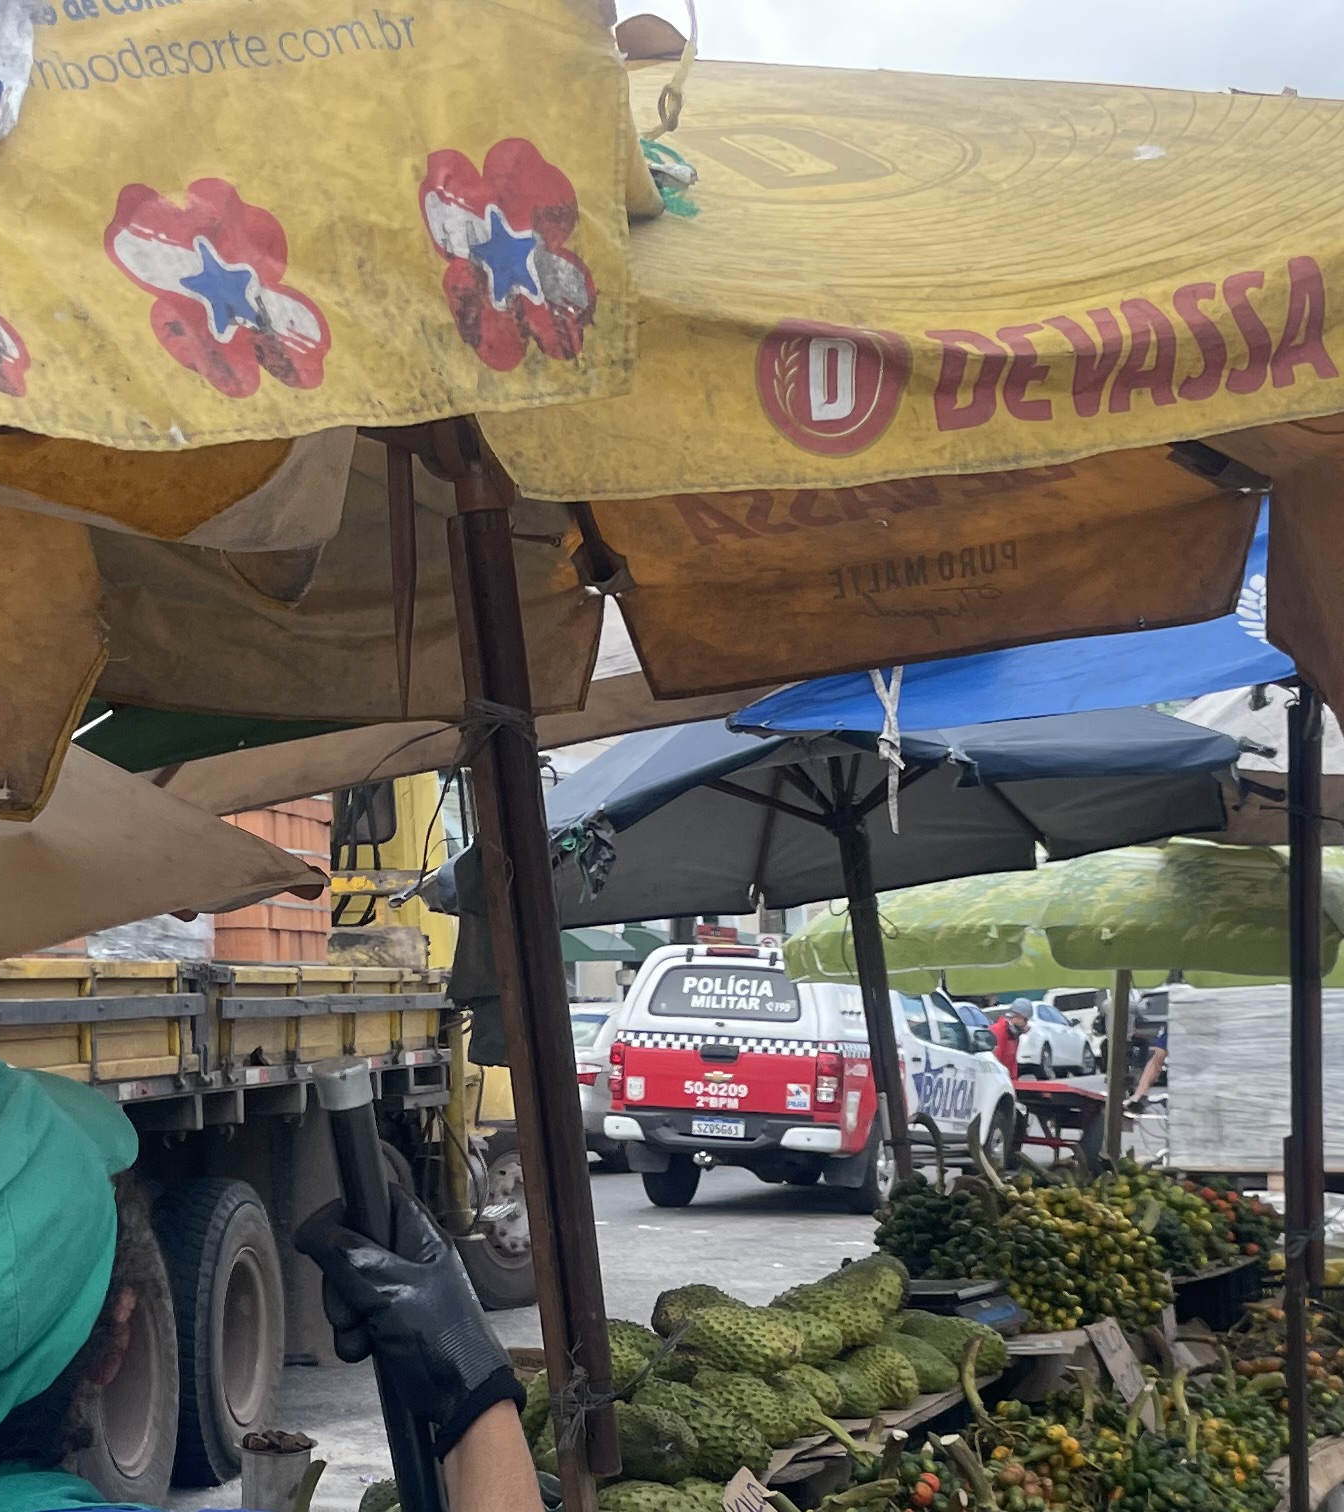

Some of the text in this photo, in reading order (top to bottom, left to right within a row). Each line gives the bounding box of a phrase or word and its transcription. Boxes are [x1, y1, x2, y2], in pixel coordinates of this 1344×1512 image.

[808, 256, 1340, 432] D DEVASSA
[682, 975, 774, 998] POLÍCIA
[690, 995, 761, 1011] MILITAR
[684, 1080, 749, 1098] 50-0209
